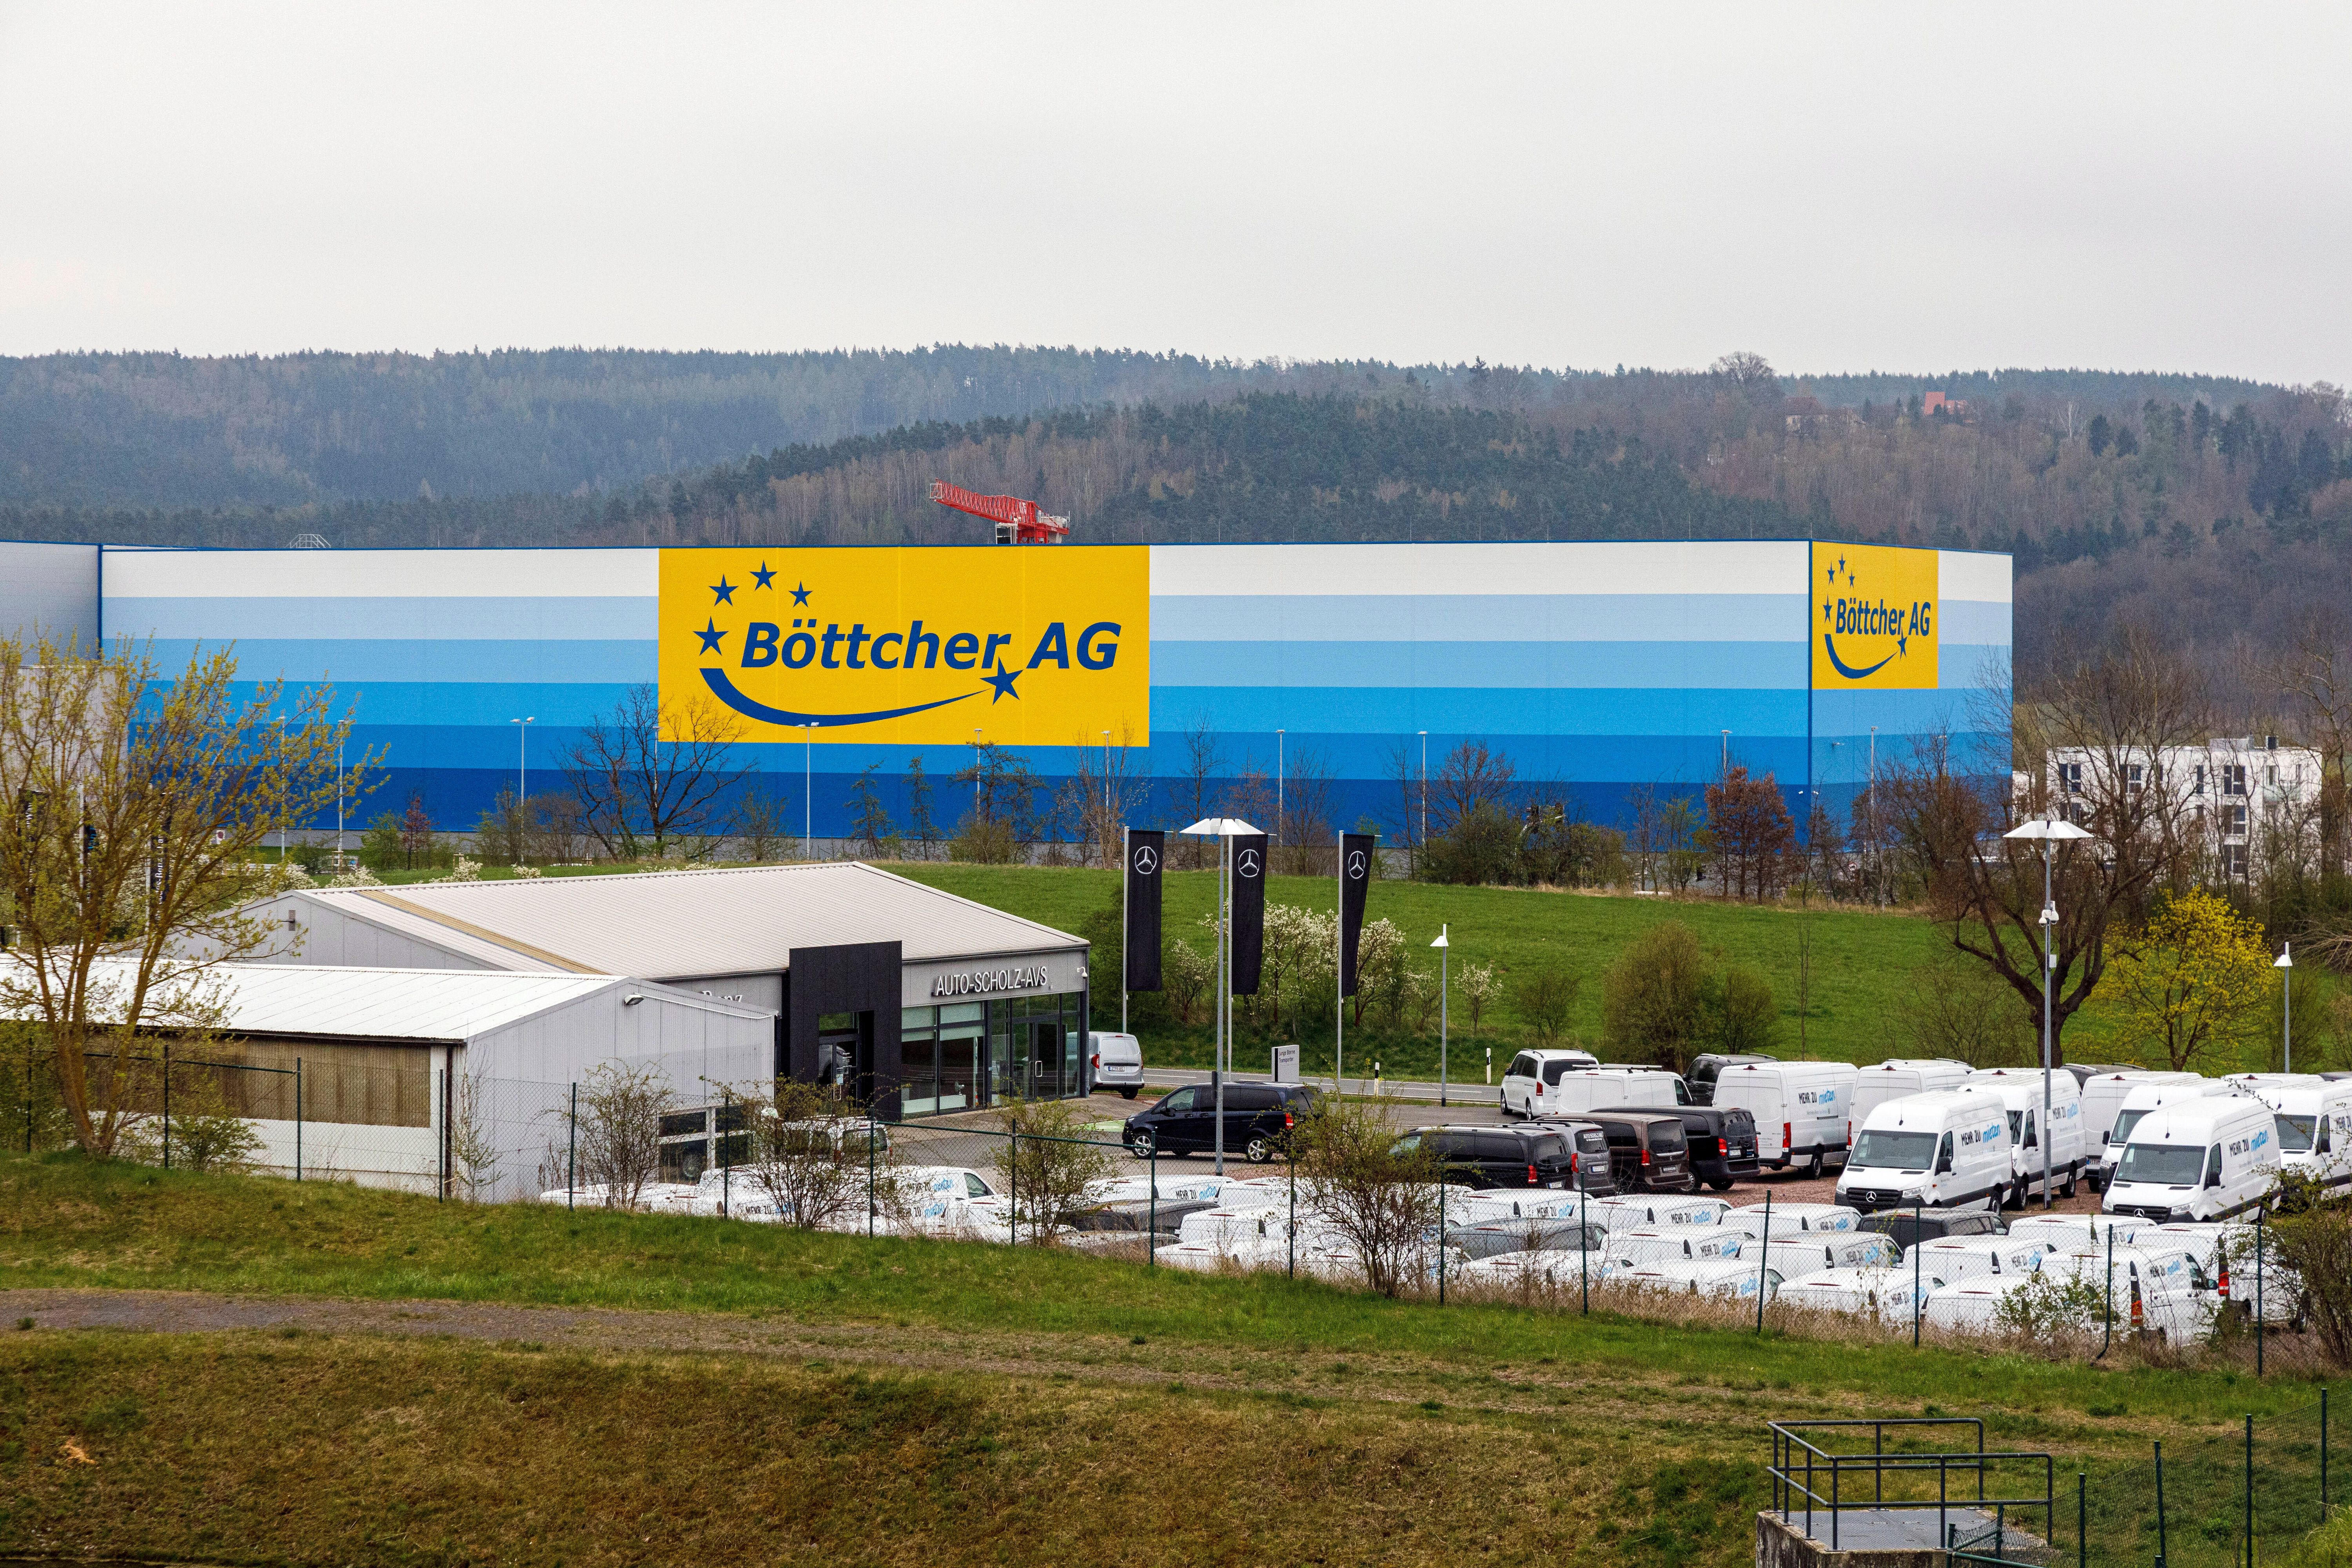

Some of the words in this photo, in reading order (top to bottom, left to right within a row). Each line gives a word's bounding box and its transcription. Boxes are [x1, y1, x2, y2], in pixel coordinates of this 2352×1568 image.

[1836, 597, 1905, 635] Böttcher
[1908, 602, 1931, 636] AG
[740, 619, 1011, 670] Böttcher
[1026, 622, 1122, 671] AG
[936, 966, 1047, 996] AUTO-SCHOLZ-AVS
[1798, 1092, 1811, 1104] MEHR
[1811, 1092, 1817, 1103] ZU
[1819, 1088, 1835, 1105] mieten
[1961, 1131, 1974, 1146] MEHR
[1974, 1130, 1981, 1143] ZU
[1982, 1123, 2001, 1143] mieten
[2229, 1141, 2242, 1157] MEHR
[2242, 1139, 2249, 1152] ZU
[1176, 1190, 1189, 1200] MEHR
[1190, 1189, 1197, 1200] ZU
[1537, 1207, 1549, 1218] MEHR
[1550, 1206, 1557, 1216] ZU
[1671, 1213, 1684, 1224] MEHR
[1685, 1212, 1691, 1223] ZU
[1700, 1244, 1713, 1257] MEHR
[1713, 1244, 1720, 1255] ZU
